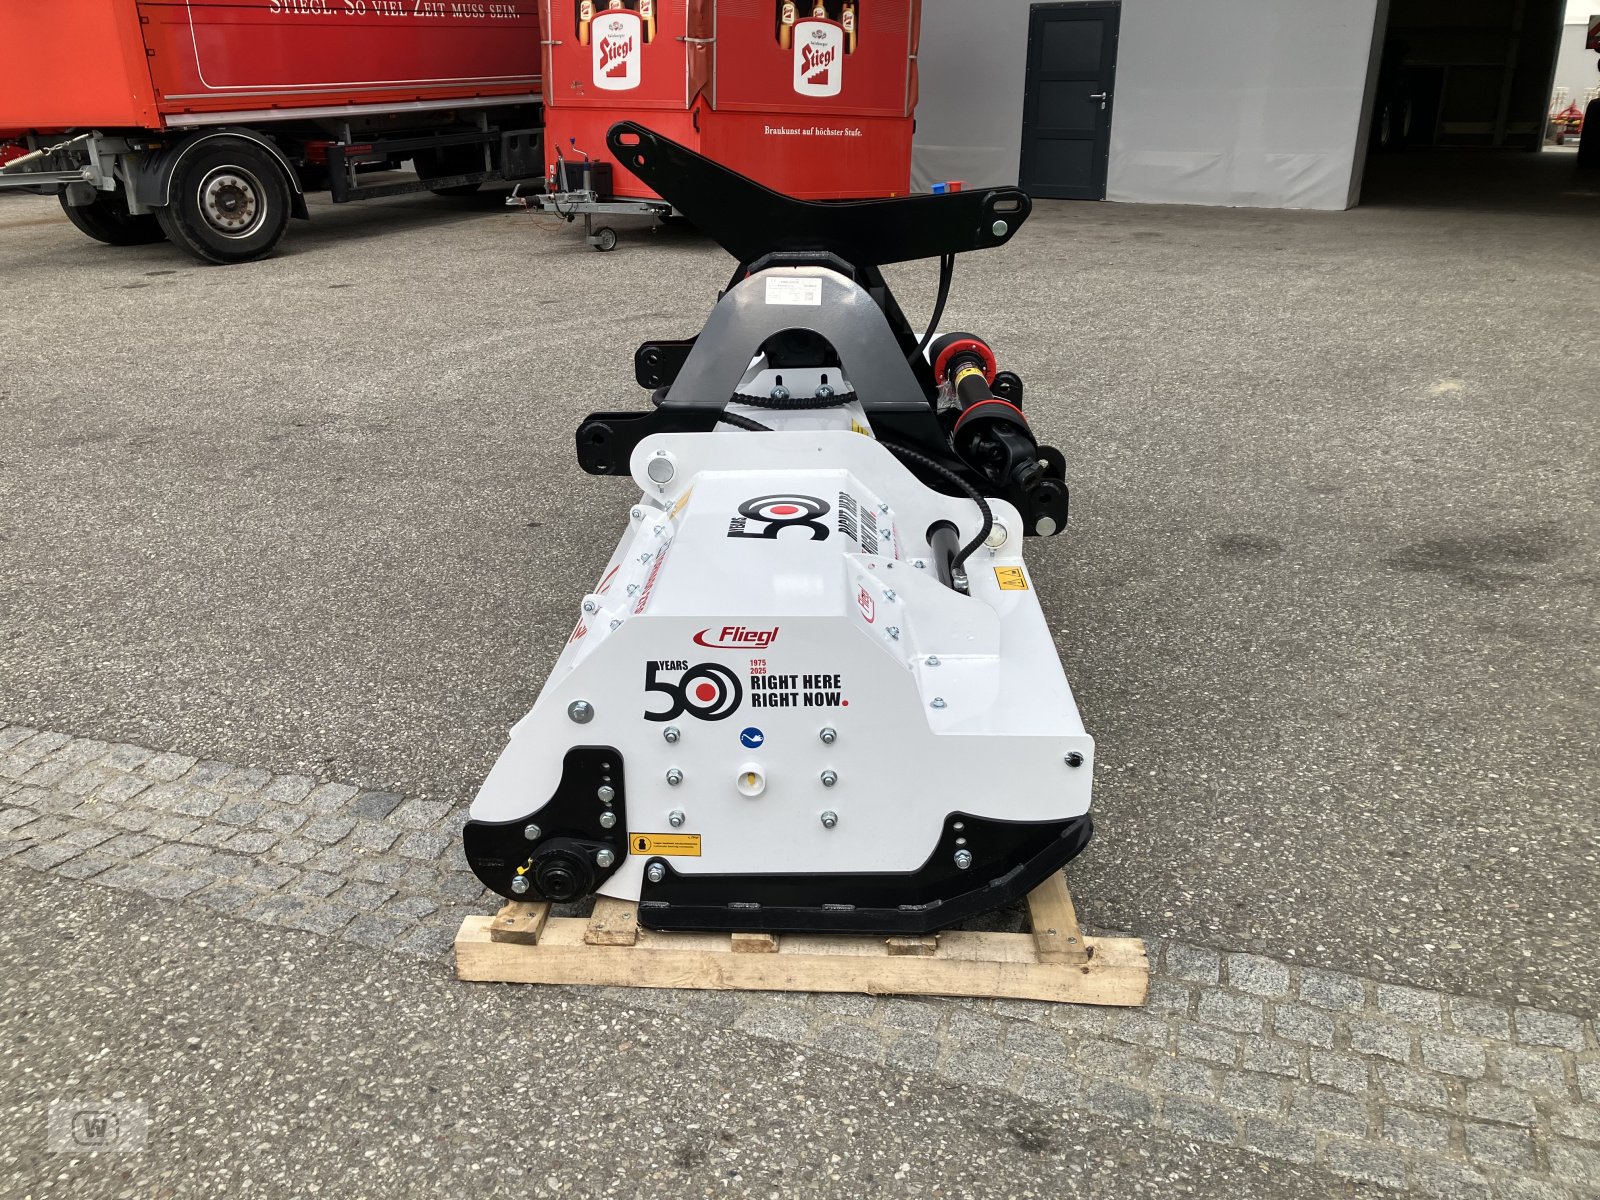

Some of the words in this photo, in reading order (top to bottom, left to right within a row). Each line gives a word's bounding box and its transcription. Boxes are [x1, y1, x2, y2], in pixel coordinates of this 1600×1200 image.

[450, 3, 485, 18] MUSS
[489, 4, 520, 18] SEIN.
[600, 35, 633, 70] Stiegl
[801, 43, 835, 76] Stiegl
[764, 125, 801, 135] Braukunst
[802, 126, 815, 136] auf
[815, 127, 844, 136] höchster
[844, 127, 863, 137] Stufe.
[719, 626, 780, 646] Fliegl
[658, 660, 689, 671] YEARS
[750, 659, 767, 667] 1975
[750, 667, 767, 675] 2025
[751, 675, 799, 690] RIGHT
[803, 674, 842, 690] HERE
[752, 692, 799, 708] RIGHT
[803, 692, 849, 707] NOW.
